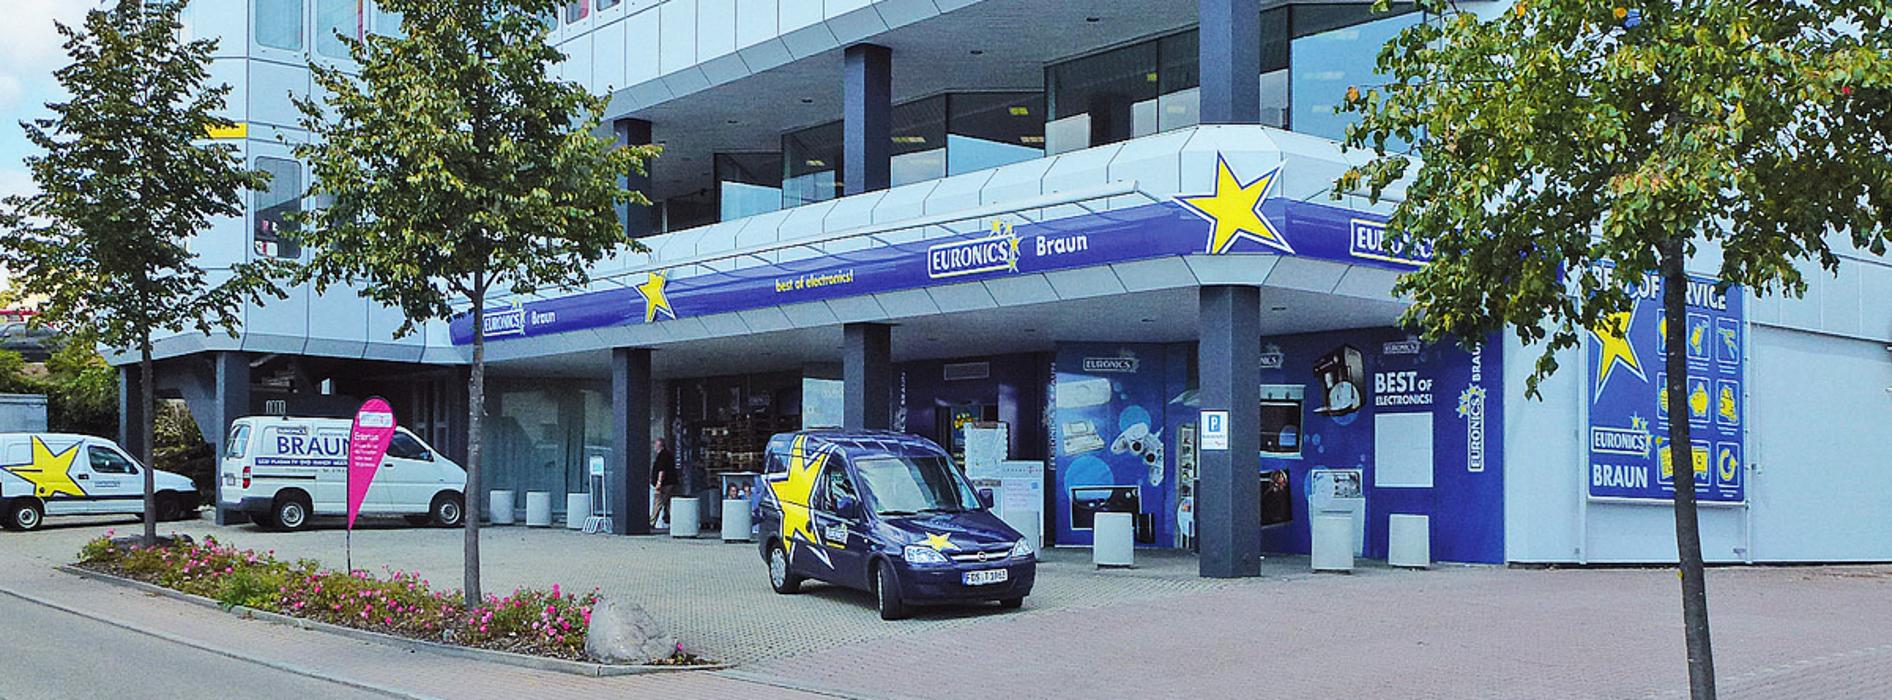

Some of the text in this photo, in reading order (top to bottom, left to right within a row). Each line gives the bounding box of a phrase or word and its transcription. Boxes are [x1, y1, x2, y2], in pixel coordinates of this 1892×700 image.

[932, 235, 1089, 270] EURONICS Braun
[775, 268, 854, 293] best of electronics!
[484, 311, 556, 332] EURONICS Braun
[1086, 360, 1131, 369] EURONICS
[1375, 371, 1433, 393] BEST OF
[1375, 394, 1433, 406] ELECTRONICS!
[1470, 342, 1481, 468] EURONICS BRAU
[1210, 416, 1218, 431] P
[1595, 431, 1645, 451] EURONICS
[1593, 464, 1649, 489] BRAUN
